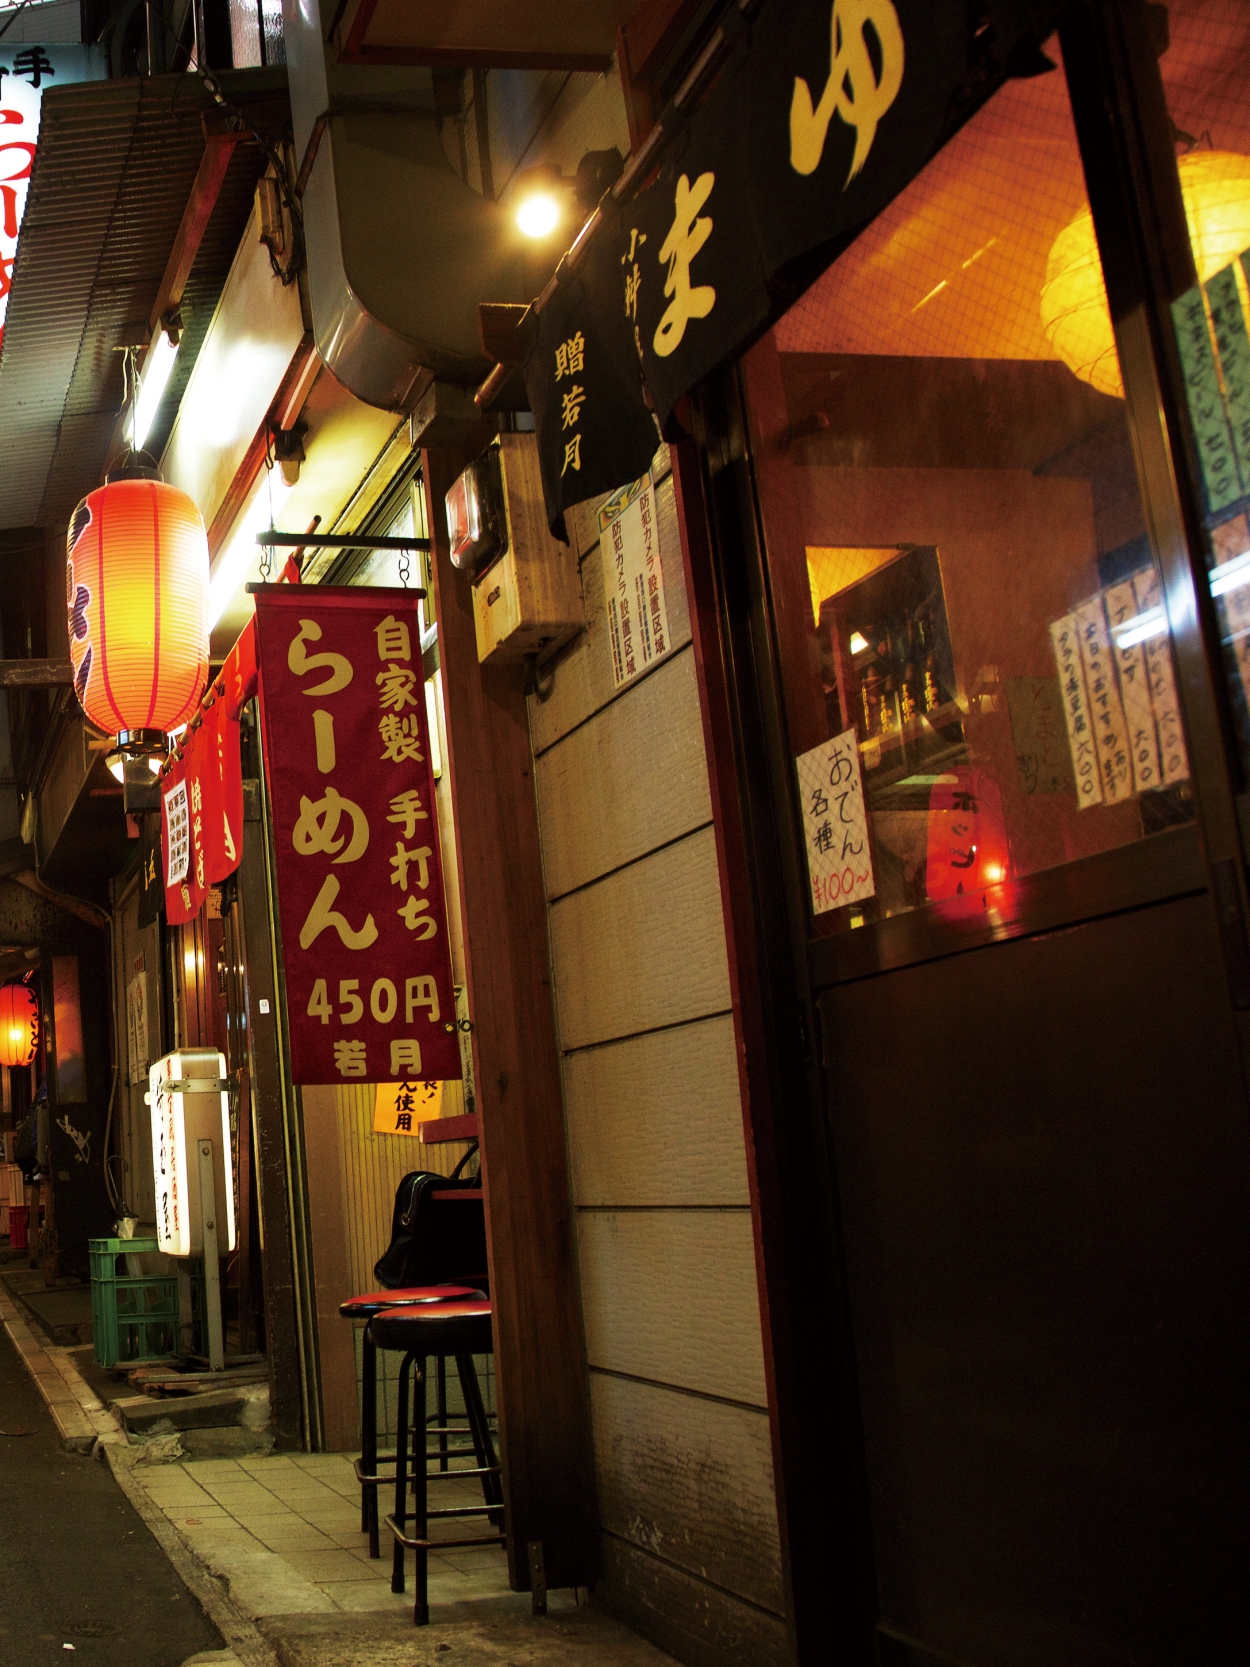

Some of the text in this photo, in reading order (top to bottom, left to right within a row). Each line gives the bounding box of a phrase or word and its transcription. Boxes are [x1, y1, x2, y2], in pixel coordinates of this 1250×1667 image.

[653, 171, 716, 357] ま
[553, 332, 586, 477] 贈若月
[286, 618, 378, 952] らーめん
[372, 615, 439, 942] 自家製 手打ち
[810, 788, 834, 855] 各種
[828, 745, 864, 860] おでん
[306, 974, 442, 1027] 450円
[332, 1039, 423, 1078] 若月
